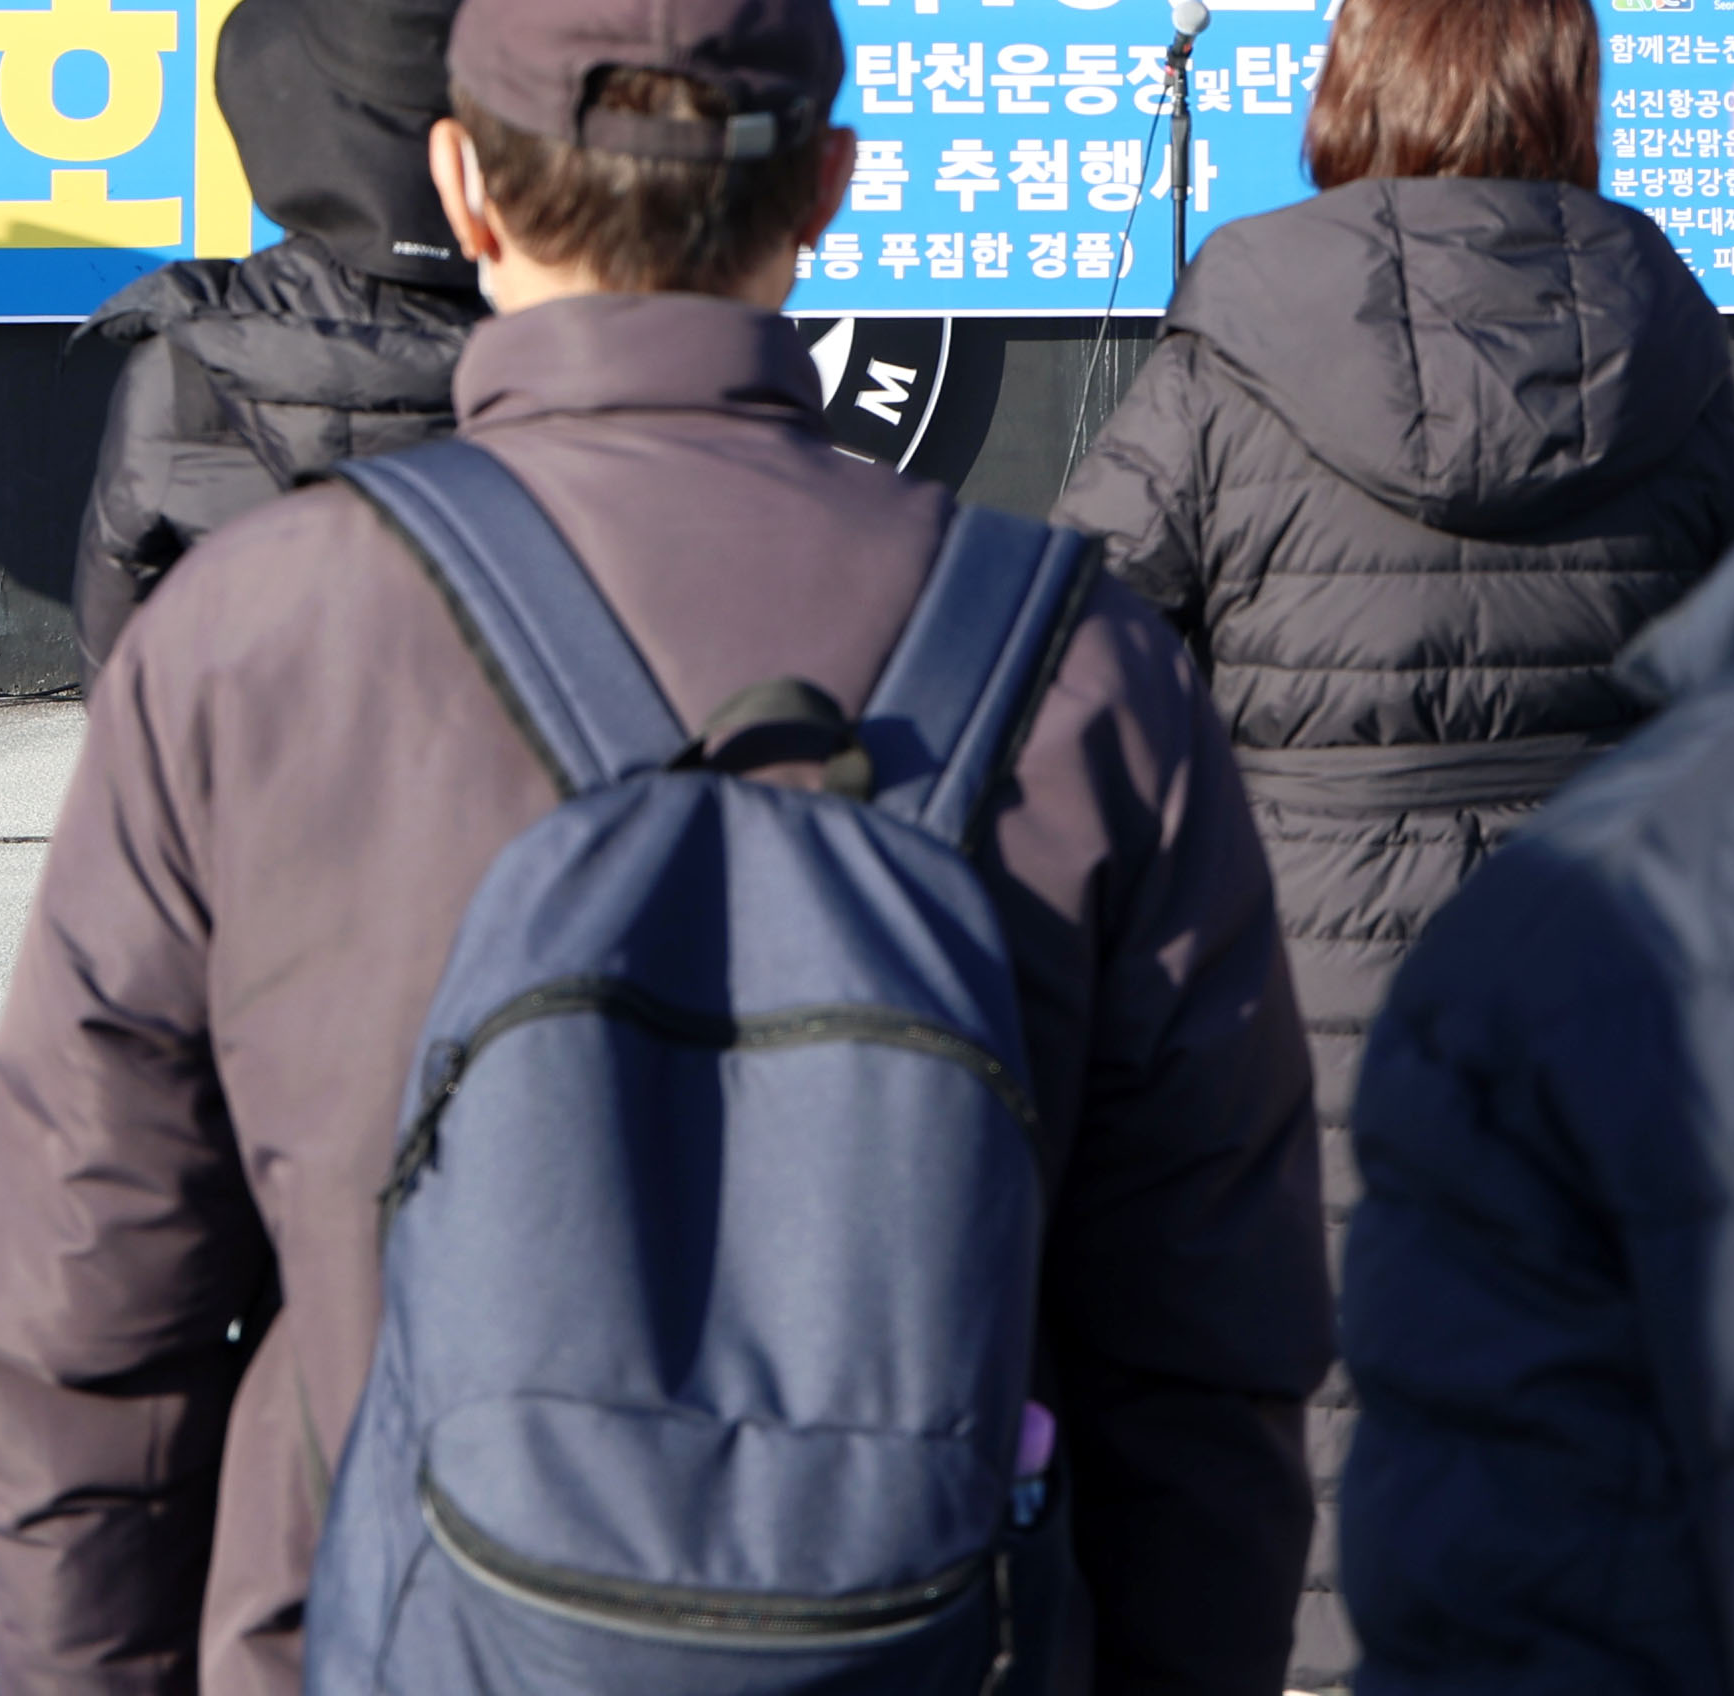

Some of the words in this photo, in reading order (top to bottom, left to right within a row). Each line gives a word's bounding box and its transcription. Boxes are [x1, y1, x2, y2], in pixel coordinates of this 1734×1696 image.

[934, 139, 1219, 213] 추첨행사
[877, 231, 1014, 280] 푸짐한
[1026, 231, 1135, 280] 경품)
